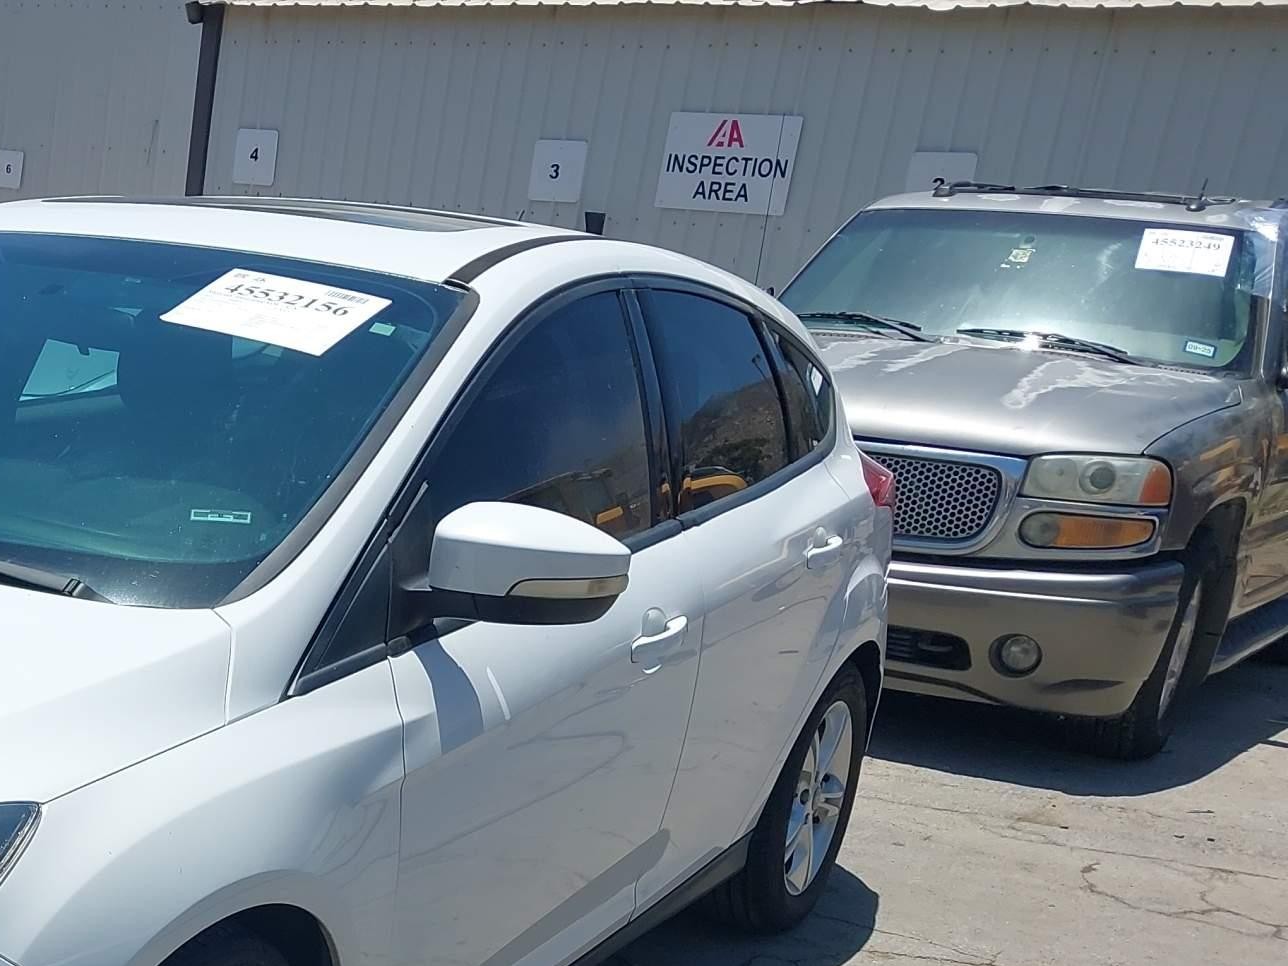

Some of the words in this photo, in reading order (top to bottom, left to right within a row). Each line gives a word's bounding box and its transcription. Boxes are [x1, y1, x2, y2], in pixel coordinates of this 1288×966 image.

[249, 146, 259, 162] 4
[5, 163, 12, 175] 6
[548, 163, 560, 180] 3
[665, 152, 789, 179] INSPECTION
[692, 180, 749, 203] AREA
[223, 283, 355, 317] 45532156
